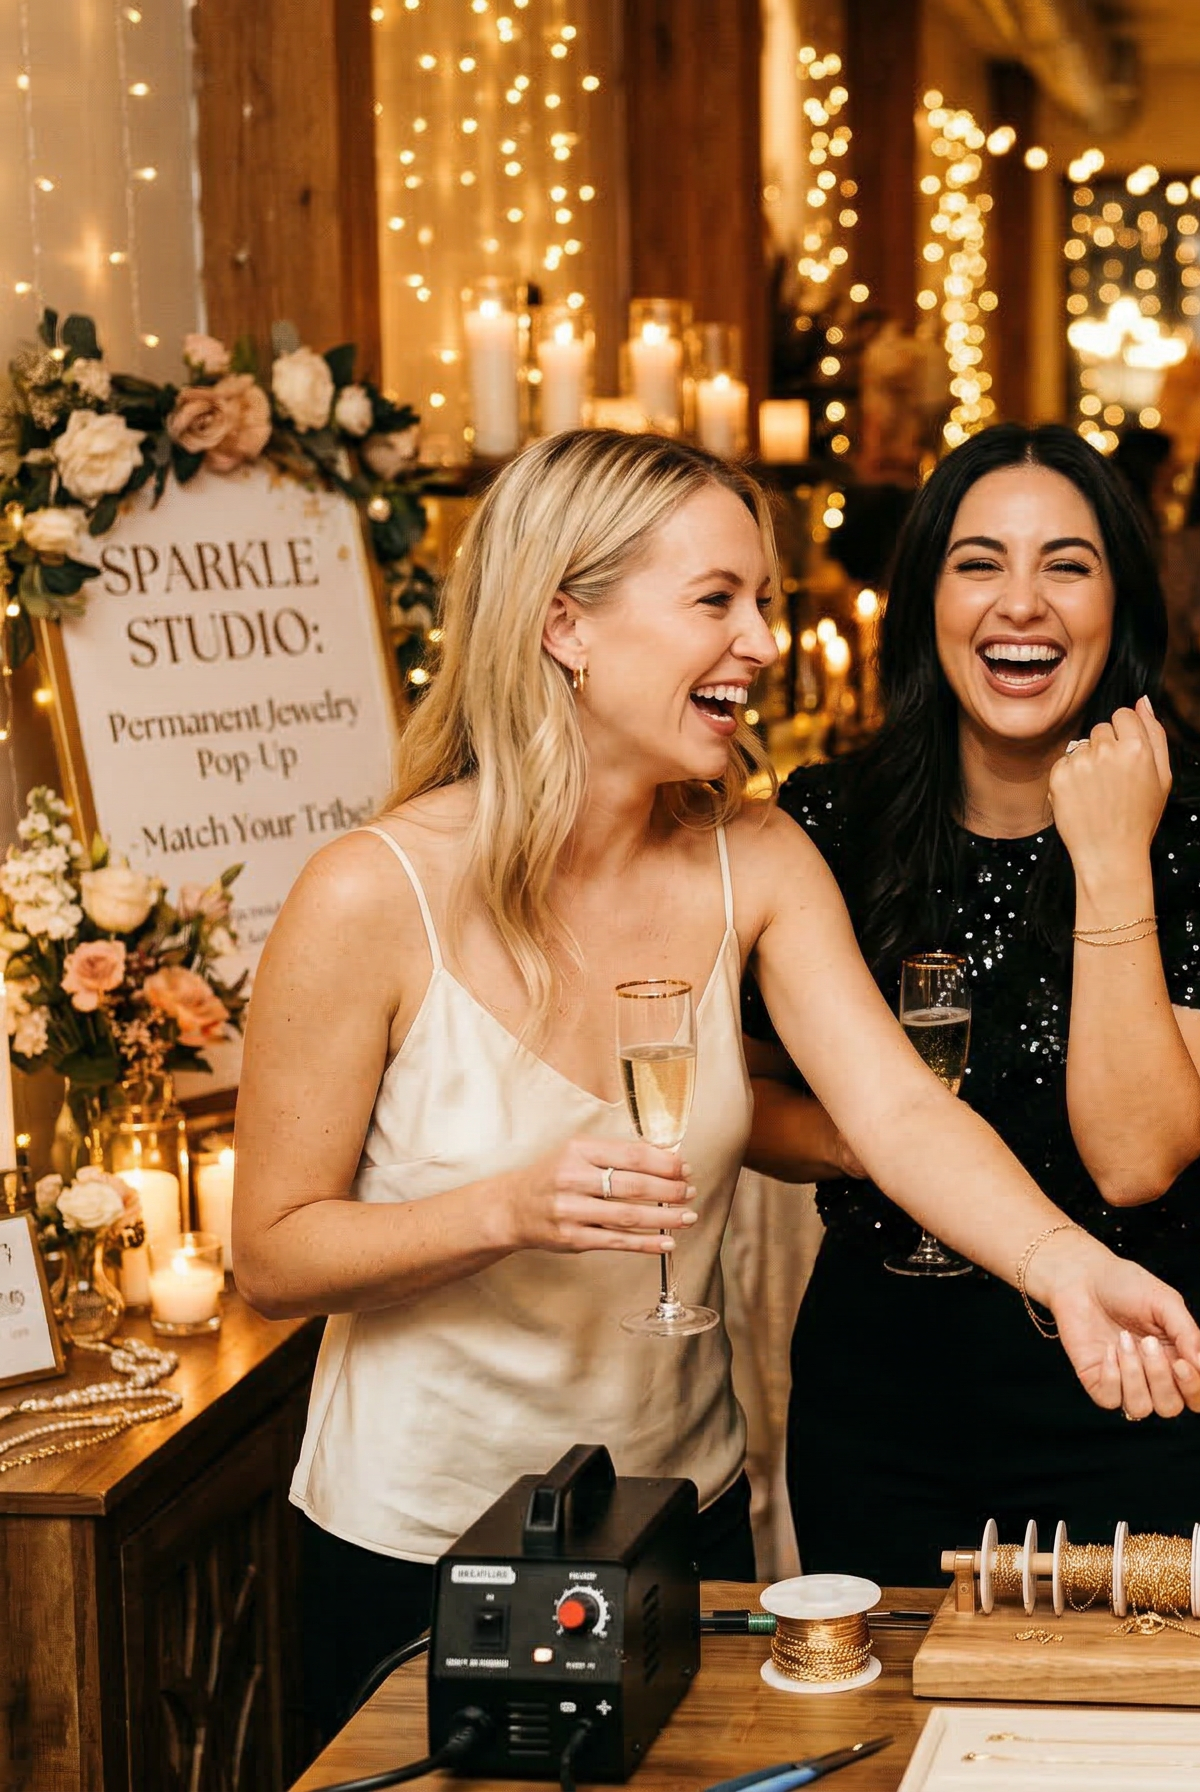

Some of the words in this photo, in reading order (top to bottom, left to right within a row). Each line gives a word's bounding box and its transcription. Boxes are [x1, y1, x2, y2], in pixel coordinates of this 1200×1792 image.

[99, 536, 320, 597] SPARKLE
[126, 606, 324, 669] STUDIO:
[107, 703, 265, 744] Permanent
[265, 688, 360, 732] Jewelry
[231, 812, 297, 845] Your
